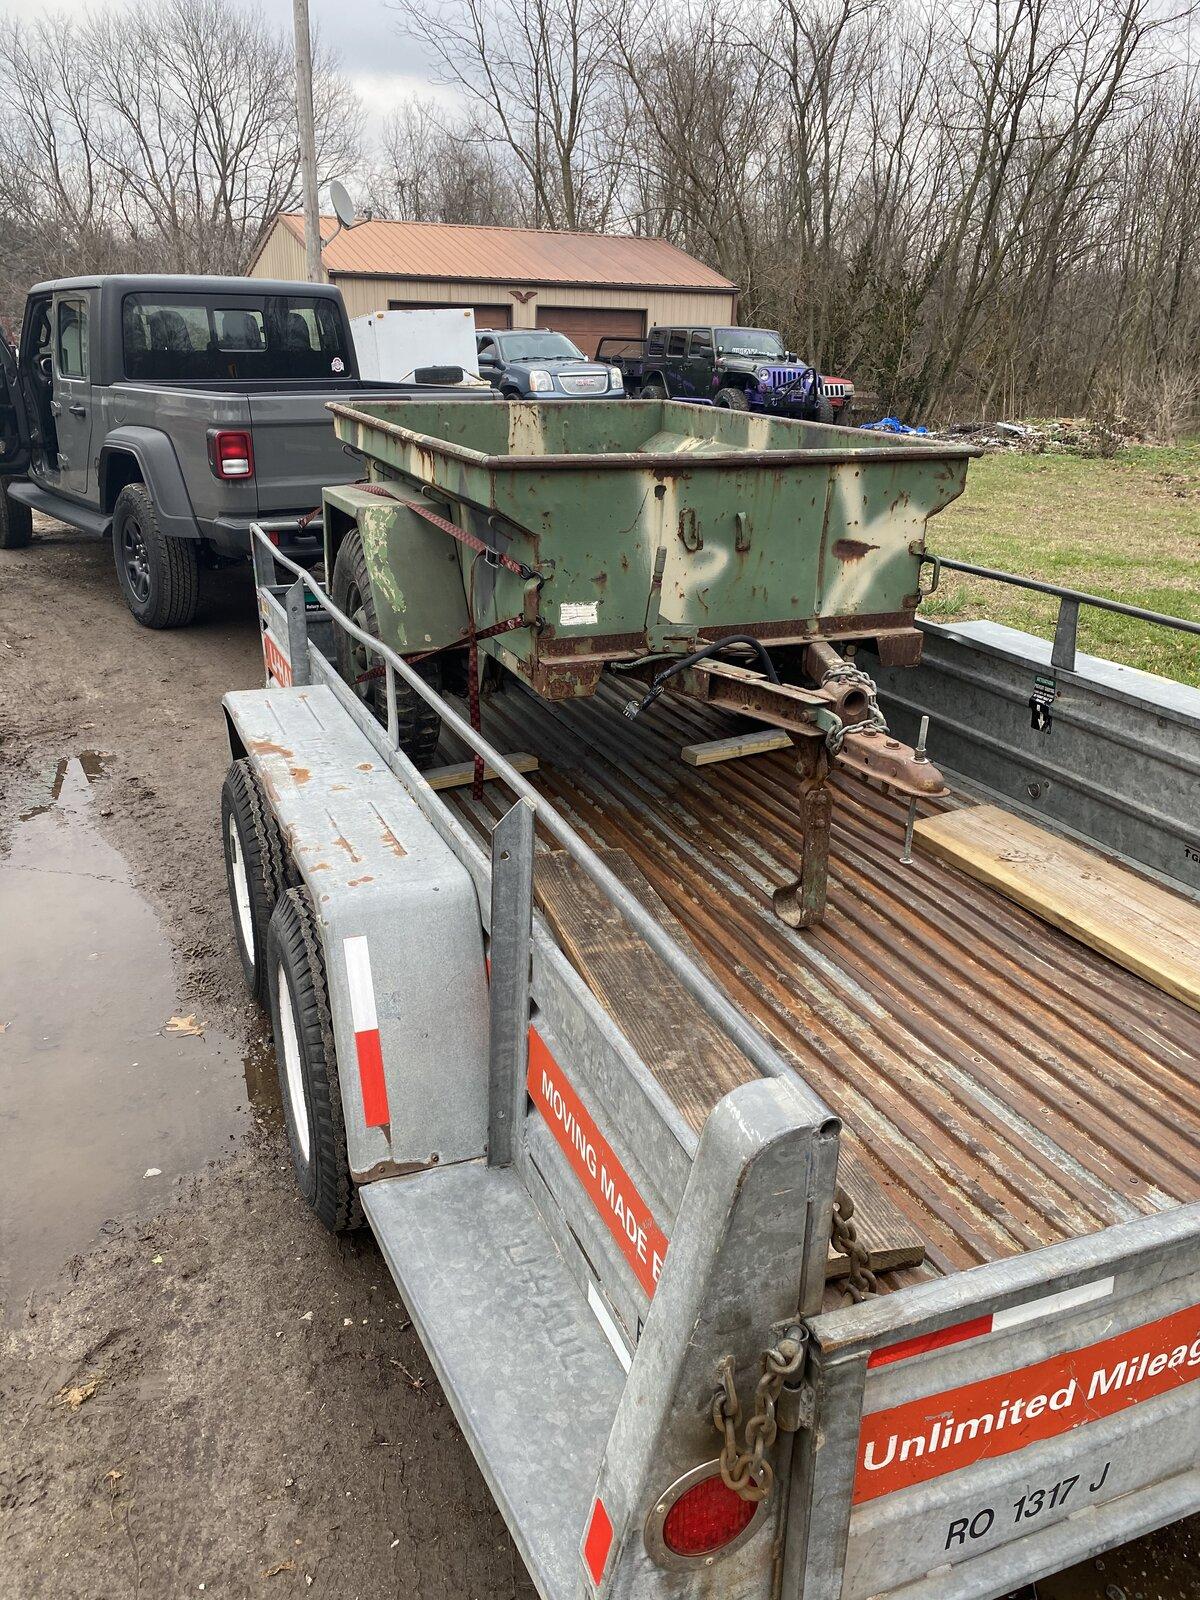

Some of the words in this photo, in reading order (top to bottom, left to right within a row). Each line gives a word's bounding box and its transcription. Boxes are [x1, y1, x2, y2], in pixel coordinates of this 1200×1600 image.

[541, 1069, 597, 1178] MOVING
[600, 1165, 647, 1264] MADE
[652, 1250, 664, 1283] E
[863, 1378, 1077, 1471] Unlimited
[1087, 1338, 1200, 1401] Mileag
[944, 1508, 995, 1550] RO
[1013, 1474, 1080, 1523] 1317
[1089, 1462, 1111, 1493] J
